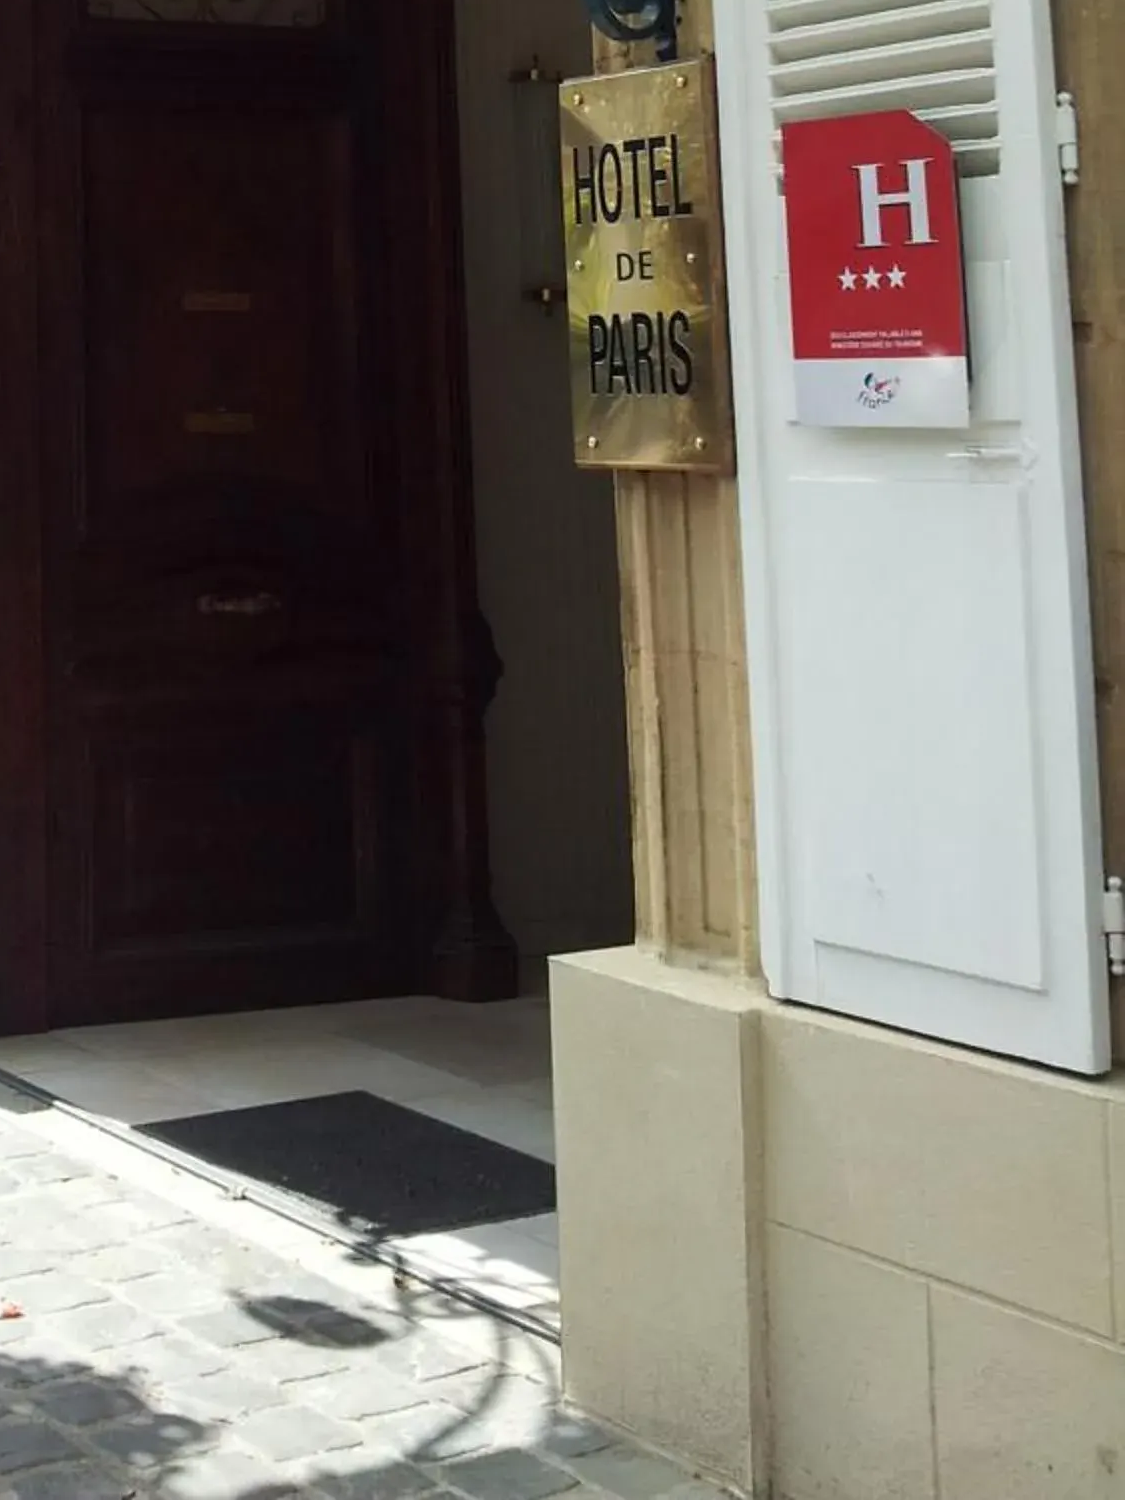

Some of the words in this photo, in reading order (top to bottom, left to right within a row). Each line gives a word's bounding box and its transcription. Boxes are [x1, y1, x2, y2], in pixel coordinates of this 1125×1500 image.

[573, 133, 694, 226] HOTEL
[850, 157, 940, 248] H
[616, 250, 654, 282] DE
[588, 309, 694, 397] PARIS
